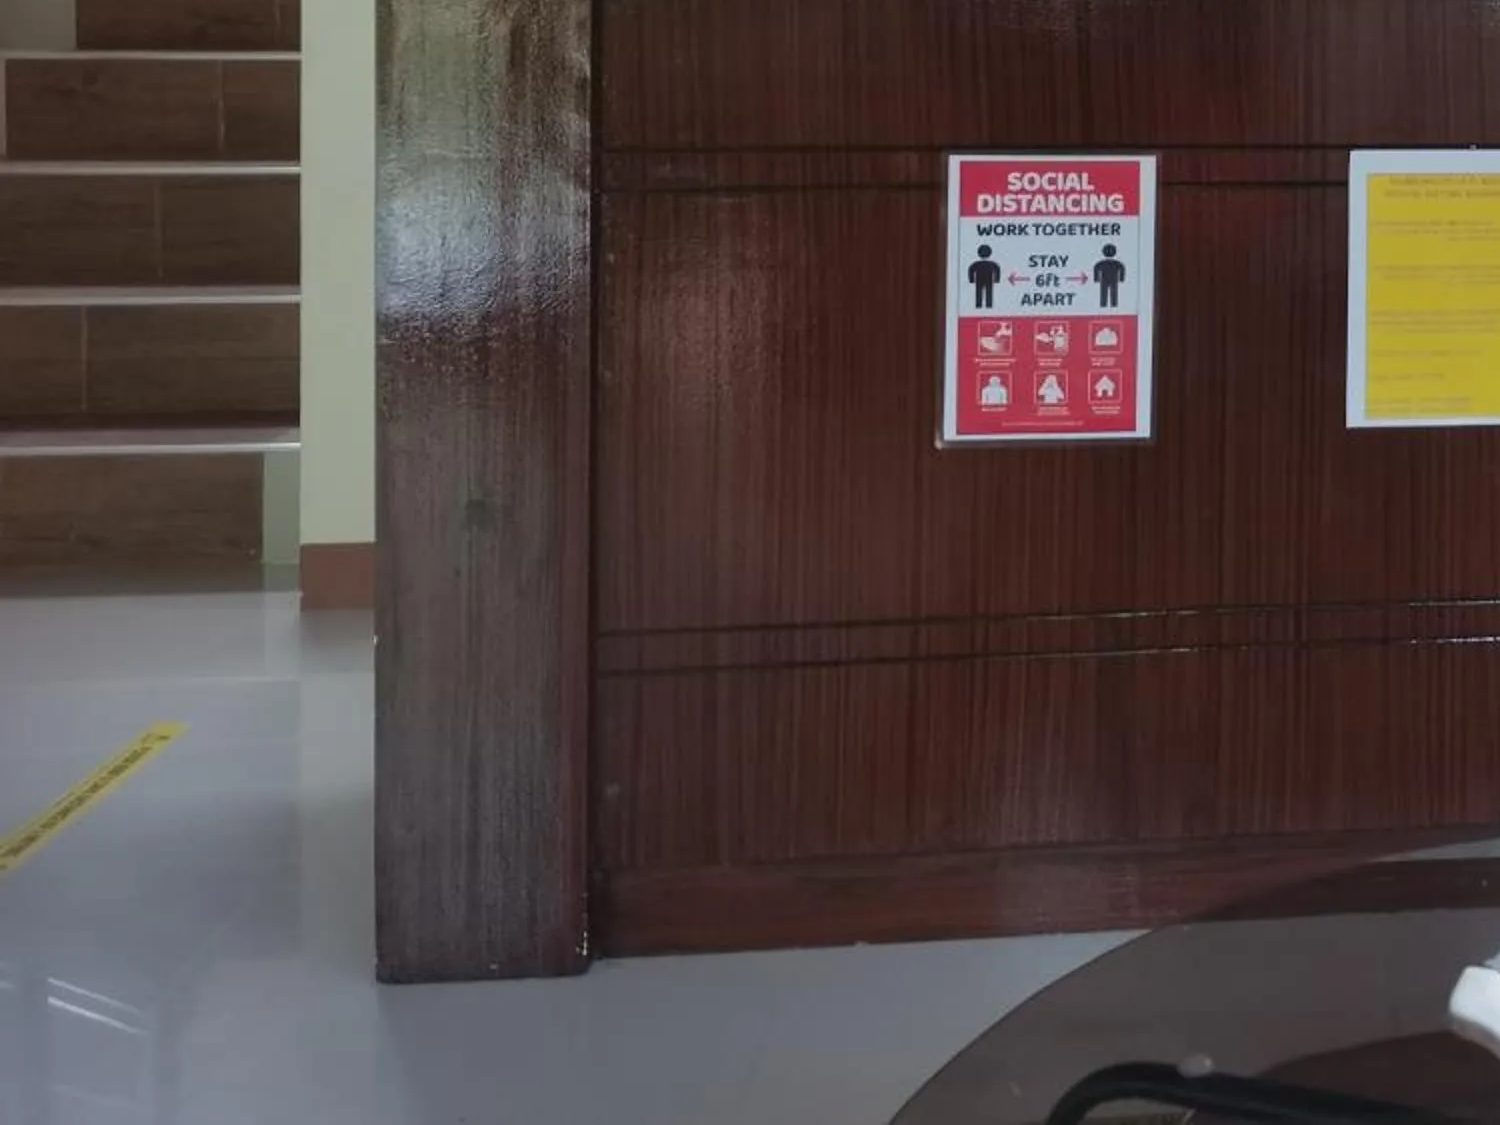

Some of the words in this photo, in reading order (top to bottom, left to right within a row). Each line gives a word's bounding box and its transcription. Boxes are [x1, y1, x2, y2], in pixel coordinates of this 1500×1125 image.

[1007, 172, 1095, 191] SOCIAL
[976, 194, 1125, 214] DISTANCING
[977, 223, 1029, 237] WORK
[1032, 223, 1121, 236] TOGETHER
[1028, 255, 1069, 268] STAY
[1035, 273, 1060, 288] 6ft
[1021, 292, 1076, 306] APART
